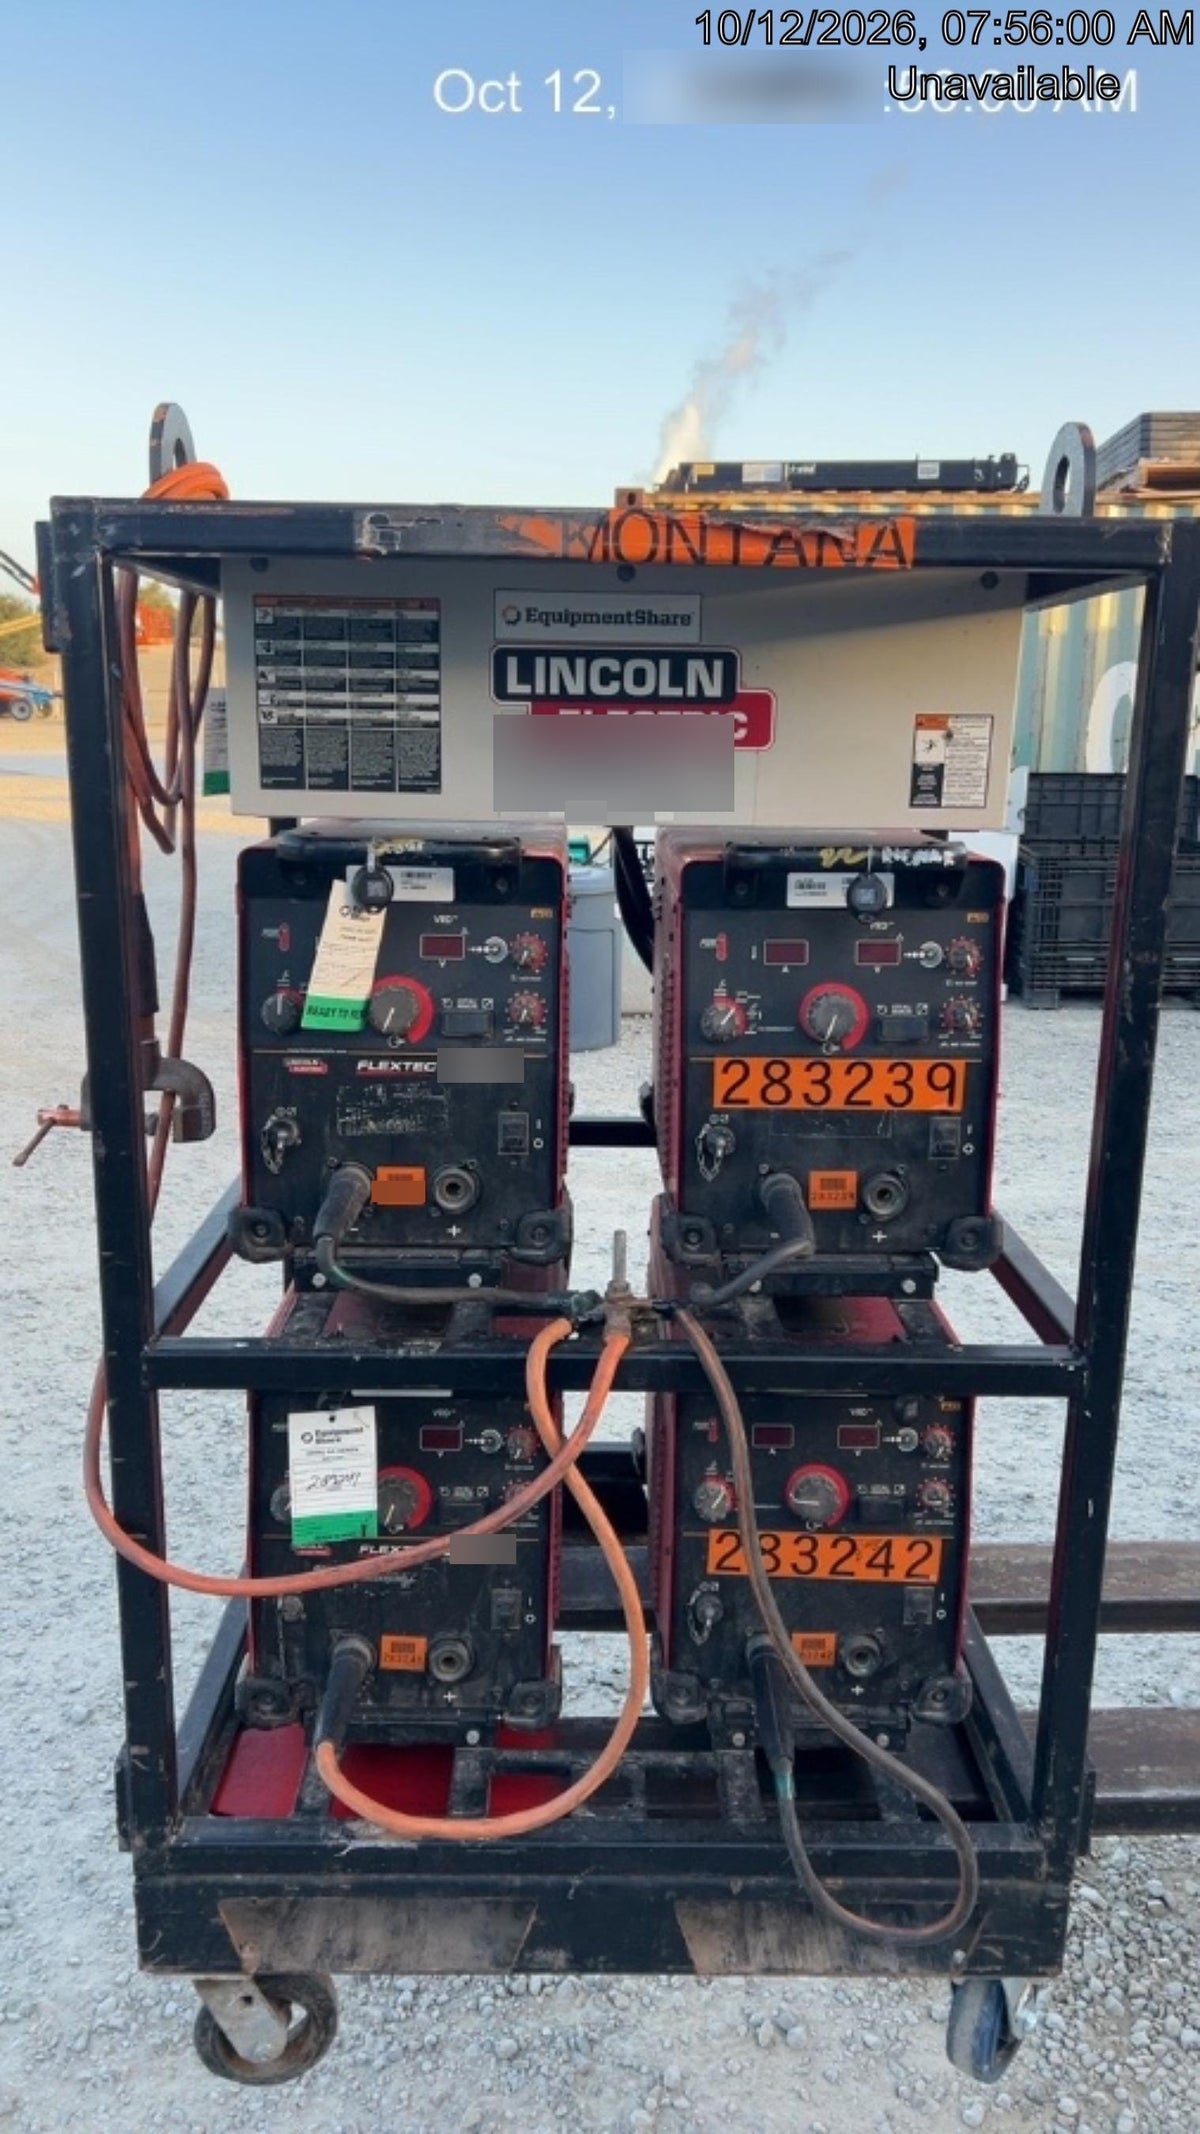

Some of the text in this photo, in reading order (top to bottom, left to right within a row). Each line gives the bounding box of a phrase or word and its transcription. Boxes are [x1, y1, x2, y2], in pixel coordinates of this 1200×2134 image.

[525, 606, 692, 627] EquipmentShare
[506, 655, 724, 698] LINCOLN
[356, 1059, 437, 1074] FLEXTEC
[720, 1058, 957, 1108] 283239
[714, 1531, 933, 1580] 283242
